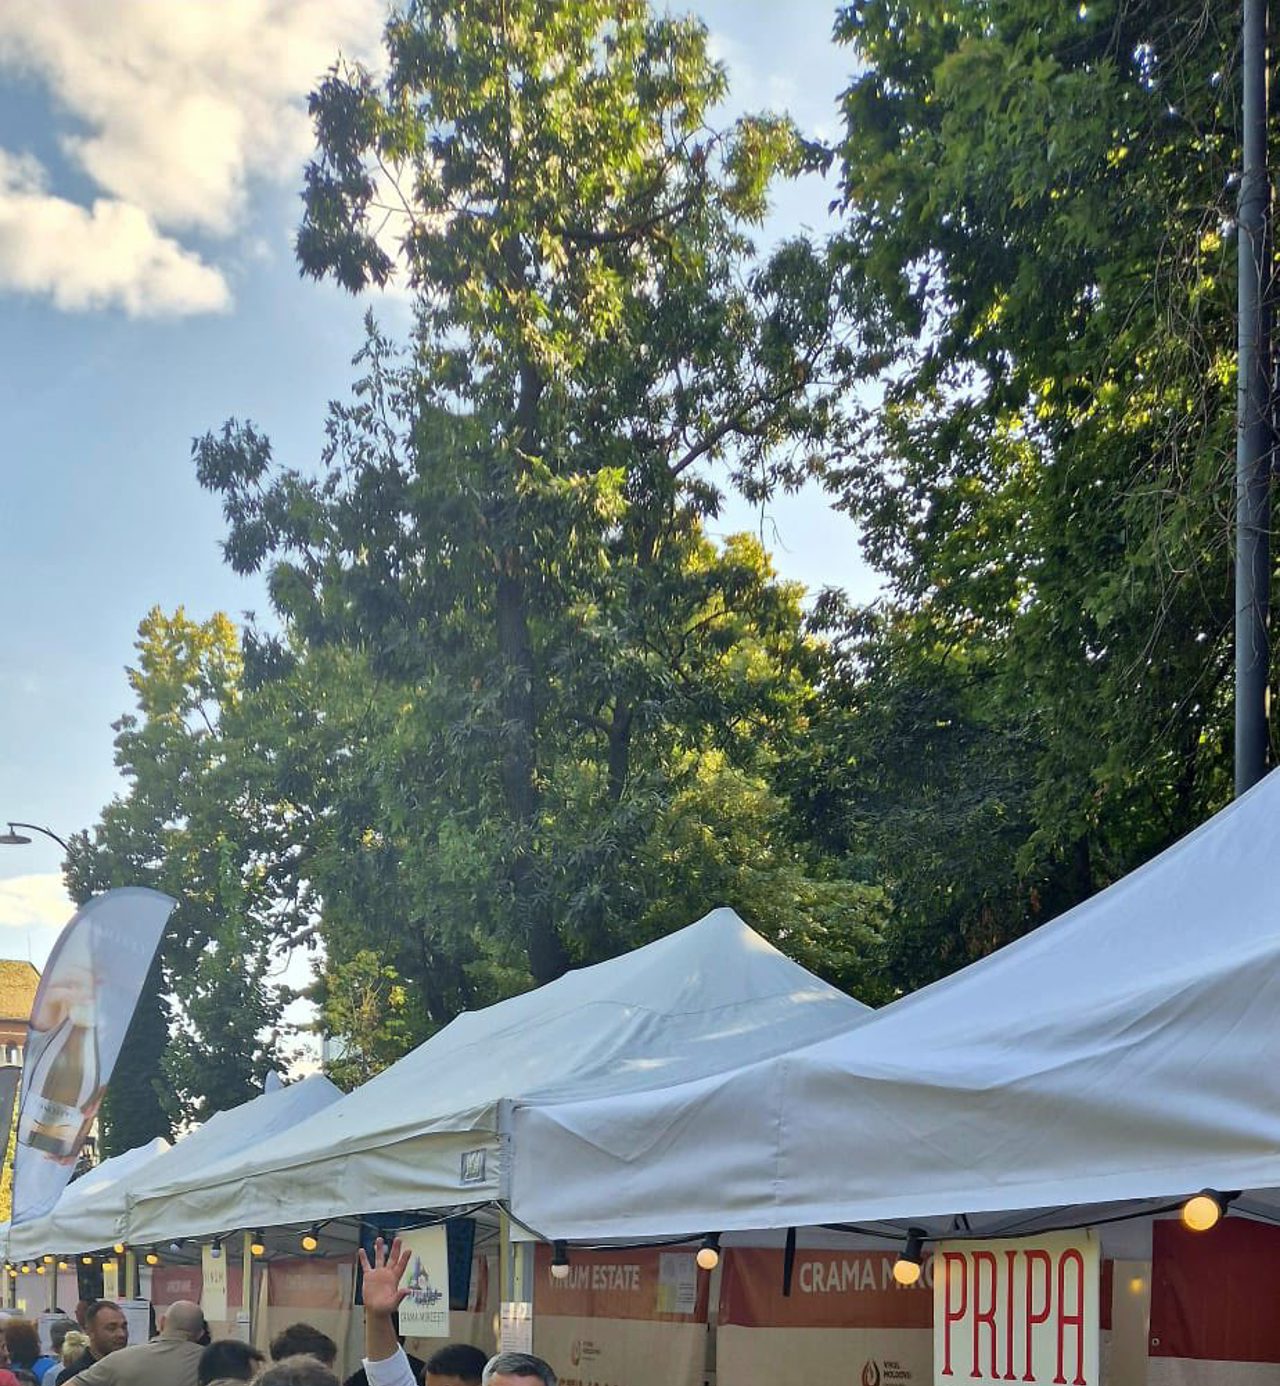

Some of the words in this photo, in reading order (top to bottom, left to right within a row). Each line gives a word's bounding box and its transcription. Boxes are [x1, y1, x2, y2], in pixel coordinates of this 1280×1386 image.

[592, 1264, 641, 1290] ESTATE
[800, 1259, 876, 1293] CRAMA
[942, 1248, 1087, 1386] PRIPA
